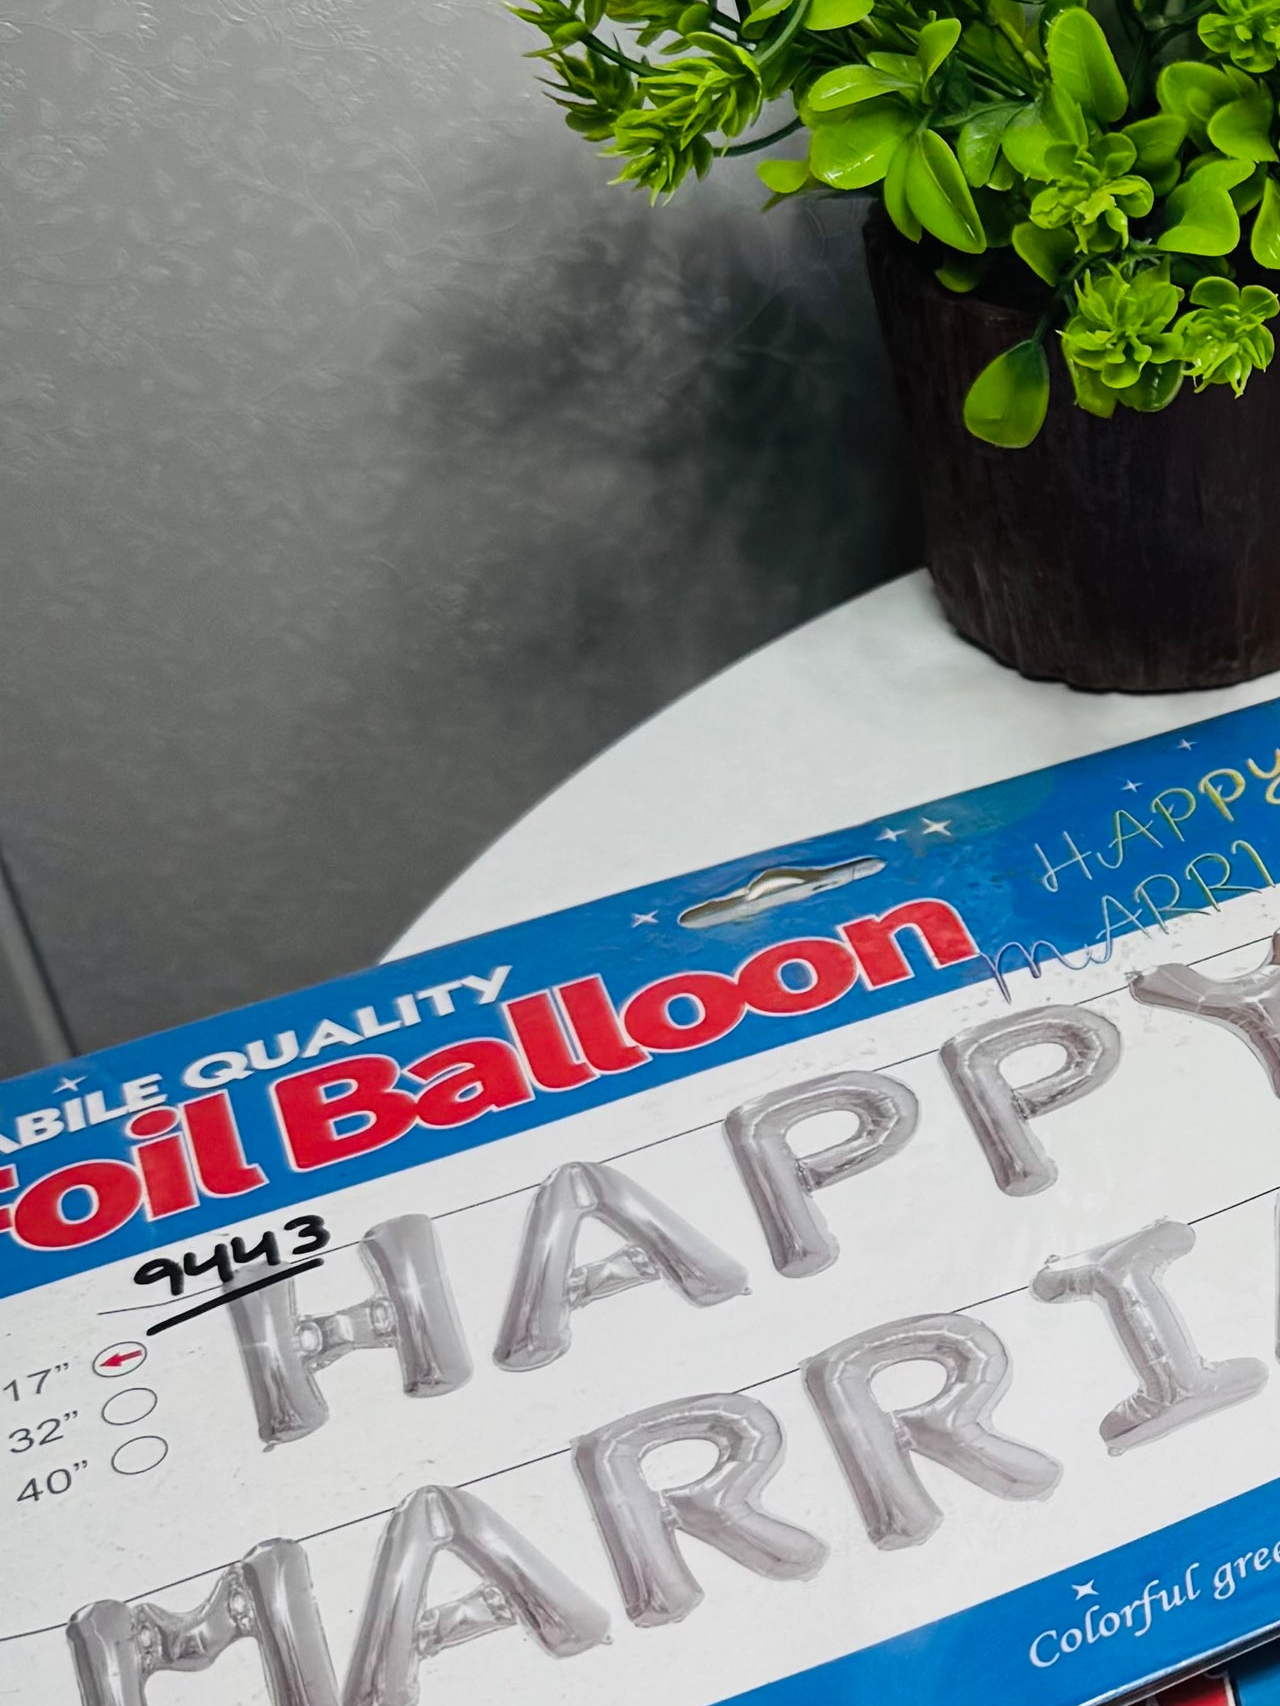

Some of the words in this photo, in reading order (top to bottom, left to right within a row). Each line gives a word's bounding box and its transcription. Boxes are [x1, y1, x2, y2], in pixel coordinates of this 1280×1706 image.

[0, 1090, 270, 1251] oil
[269, 897, 977, 1174] Balloon
[182, 964, 512, 1088] QUALITY
[134, 1215, 330, 1294] 9443
[1029, 1563, 1201, 1668] Colorful
